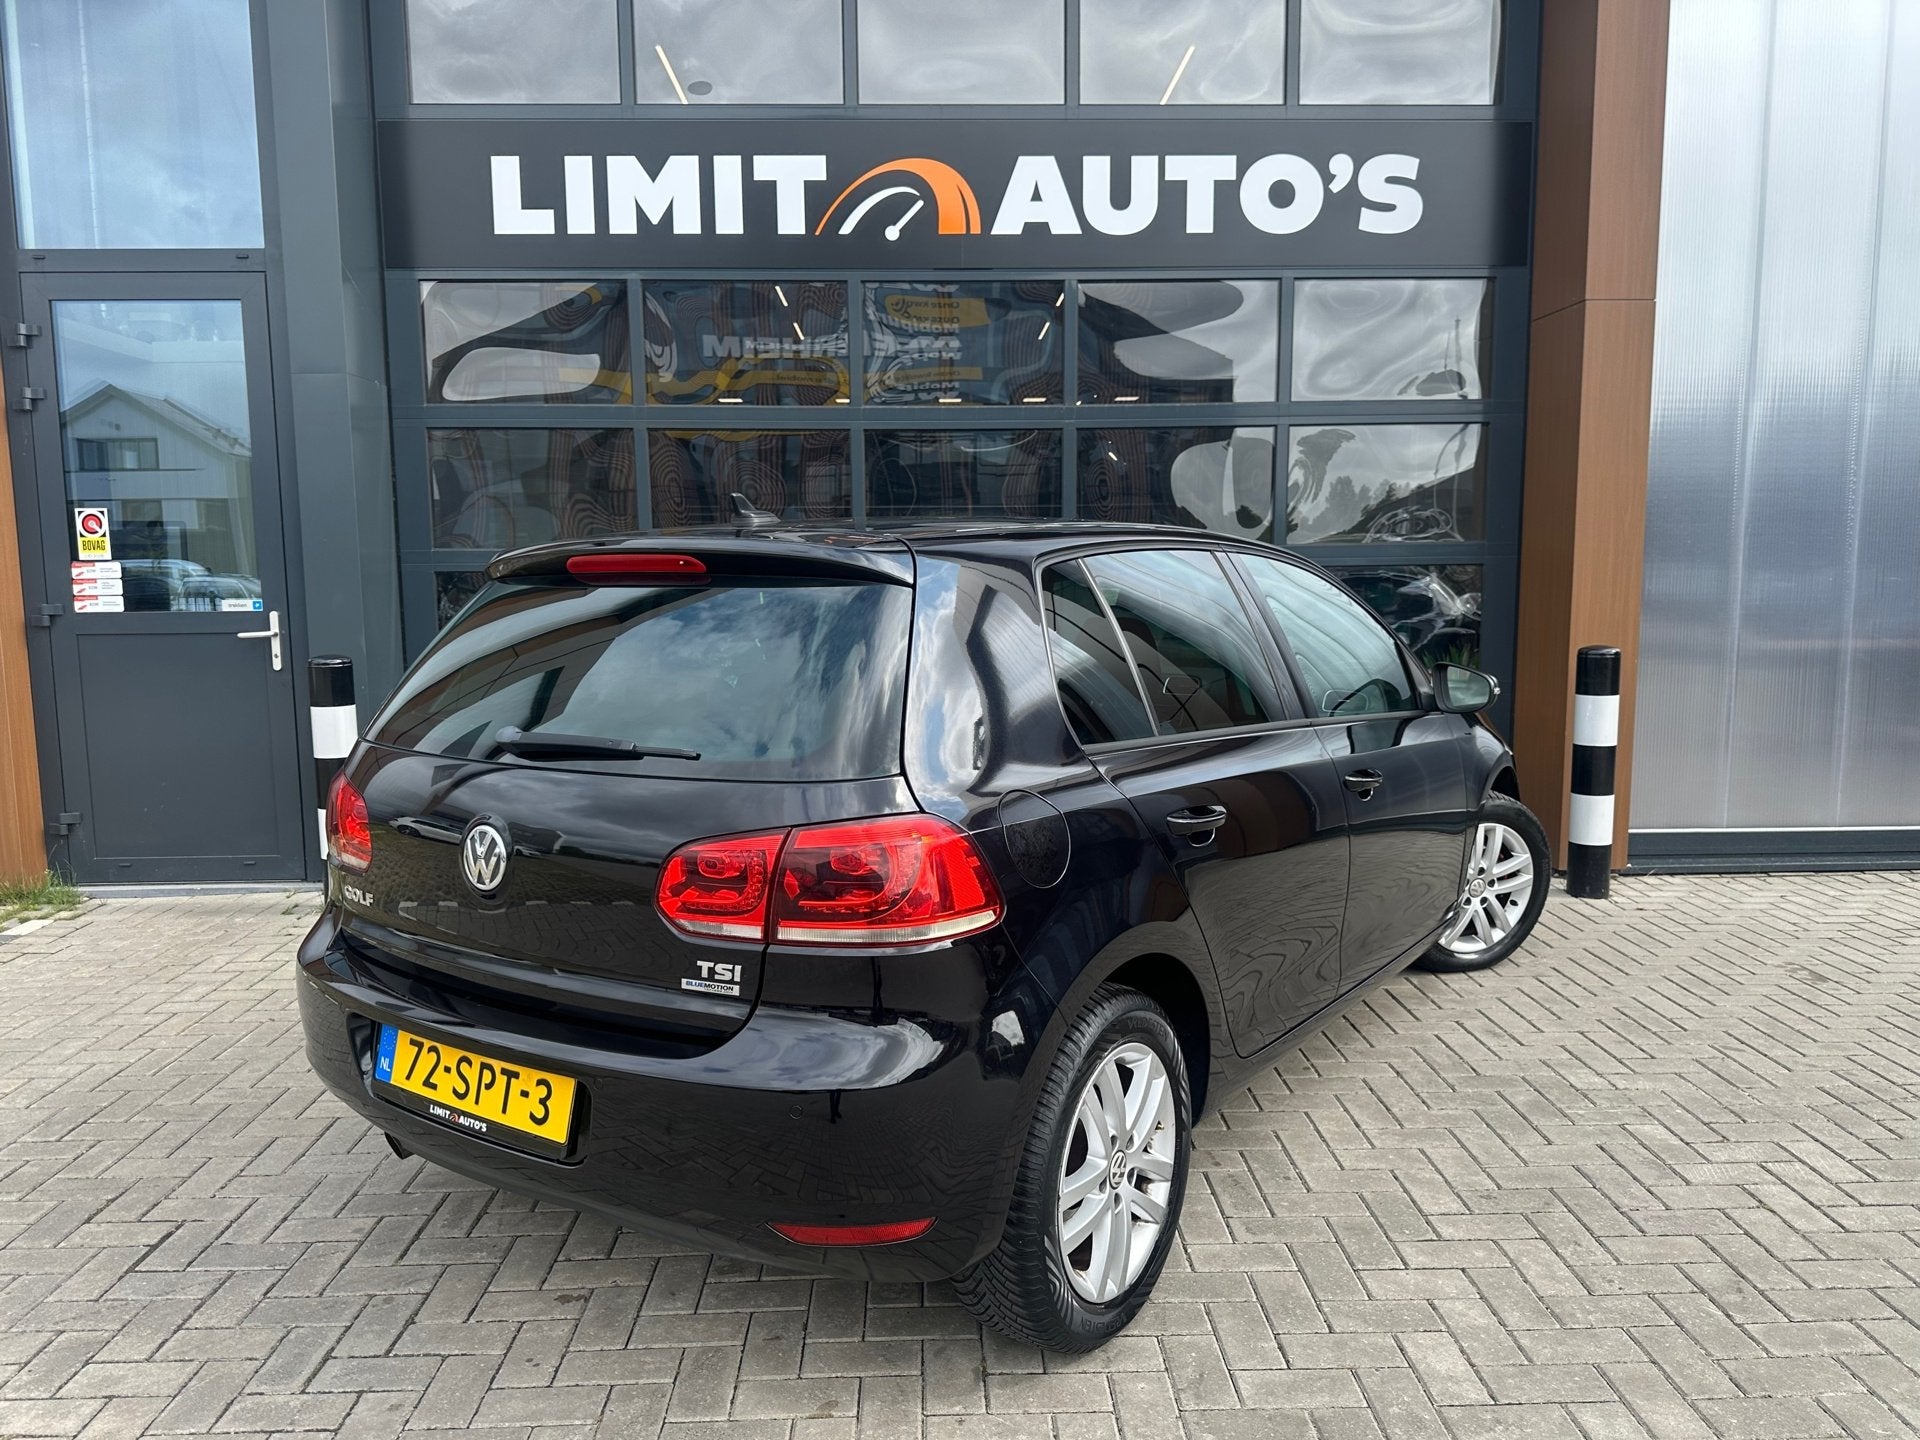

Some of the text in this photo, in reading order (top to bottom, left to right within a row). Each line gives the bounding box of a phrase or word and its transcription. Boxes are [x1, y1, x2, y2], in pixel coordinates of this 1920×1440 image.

[490, 154, 1423, 237] LIMIT AUTO'S
[82, 539, 106, 551] BOVAG
[344, 884, 374, 907] GOLF
[696, 960, 742, 982] TSI
[379, 1056, 391, 1072] NL
[405, 1037, 553, 1126] 72-SPT-3
[430, 1104, 487, 1132] LIMIT AUTO'S
